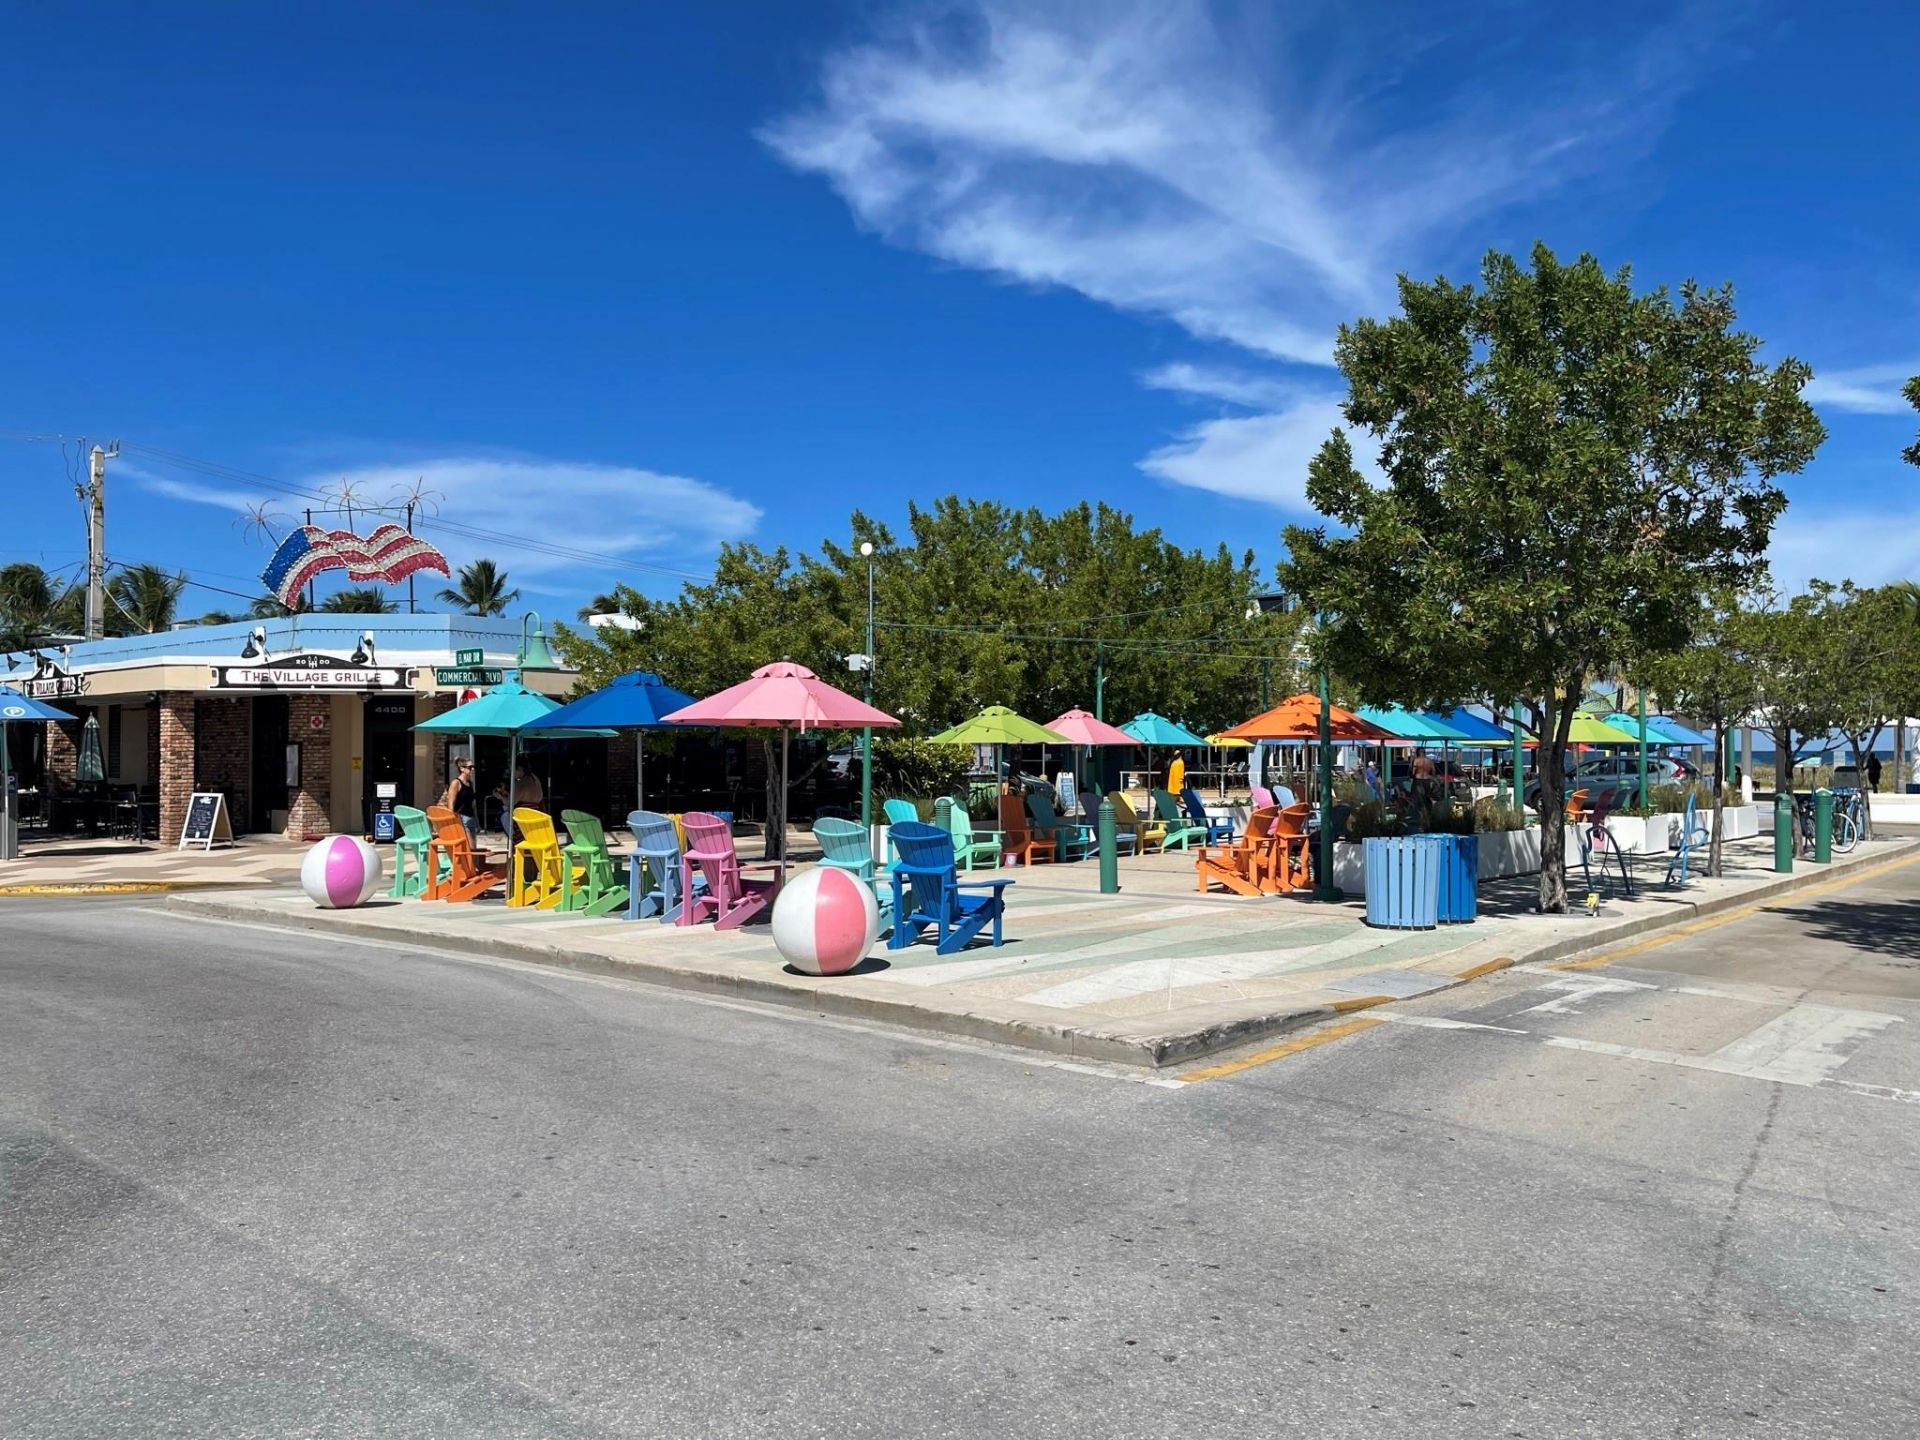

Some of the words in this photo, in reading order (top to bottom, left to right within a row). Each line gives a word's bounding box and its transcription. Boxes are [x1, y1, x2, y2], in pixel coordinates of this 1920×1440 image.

[463, 652, 472, 663] MAR
[472, 651, 480, 663] DR
[240, 670, 269, 682] THE
[273, 670, 329, 682] VILLAGE
[334, 672, 382, 683] GRILLE
[437, 671, 482, 683] COMMERCIAL
[485, 671, 502, 683] BLVD
[374, 706, 406, 714] 4400
